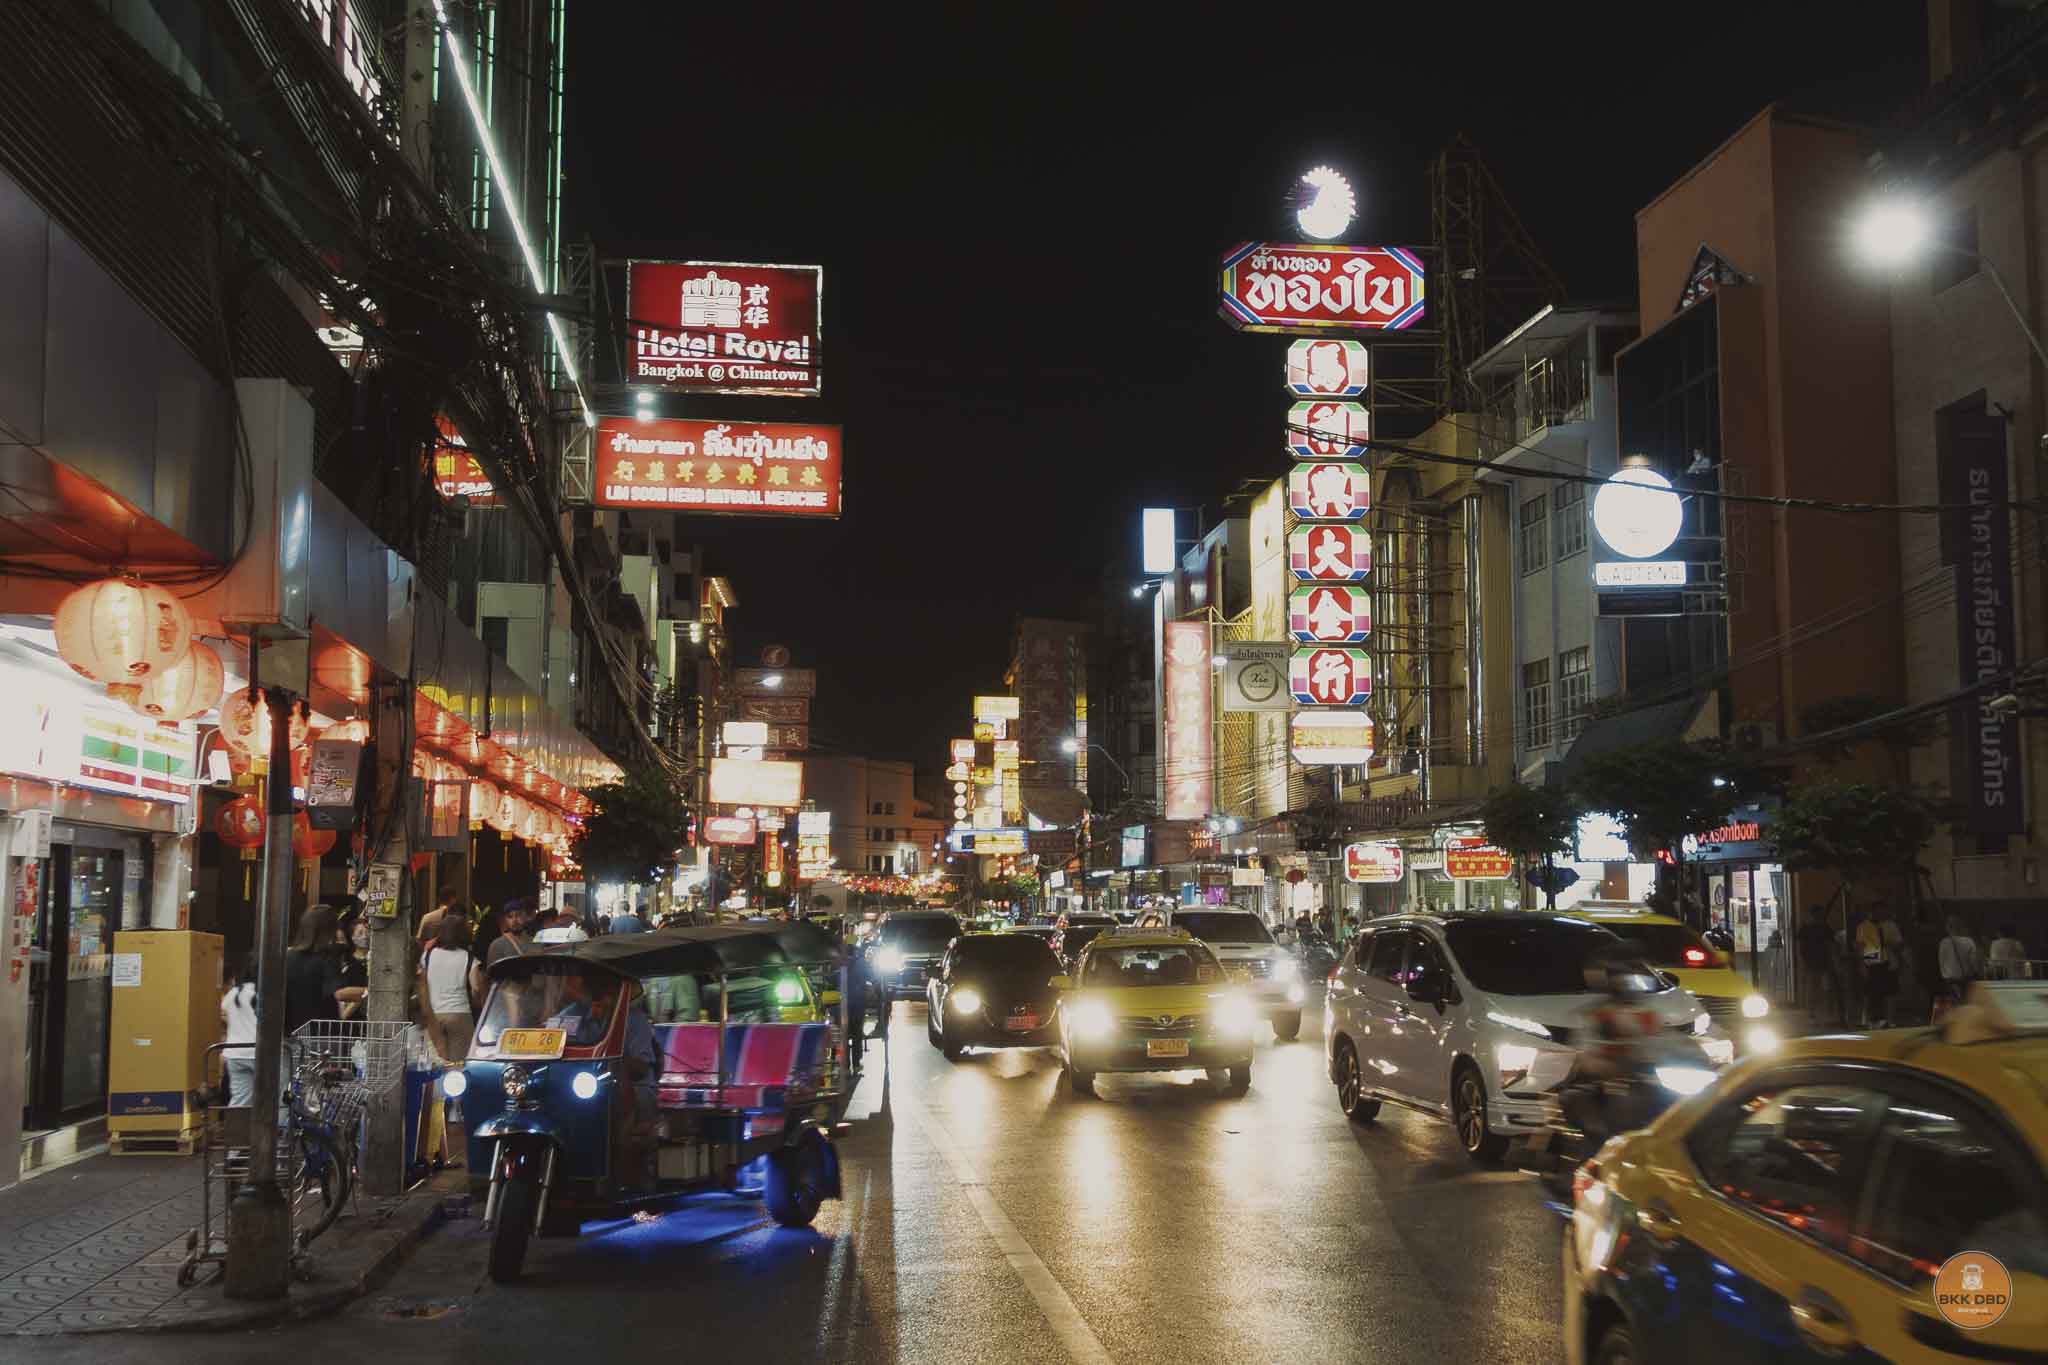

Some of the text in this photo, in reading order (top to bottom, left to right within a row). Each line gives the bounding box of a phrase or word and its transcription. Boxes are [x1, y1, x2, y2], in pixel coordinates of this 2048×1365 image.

[1250, 248, 1332, 274] ห้างทอง
[1244, 257, 1406, 317] ทองใบ
[637, 330, 809, 361] Hotel Royal
[638, 362, 809, 382] Bangkok @ Chinatown
